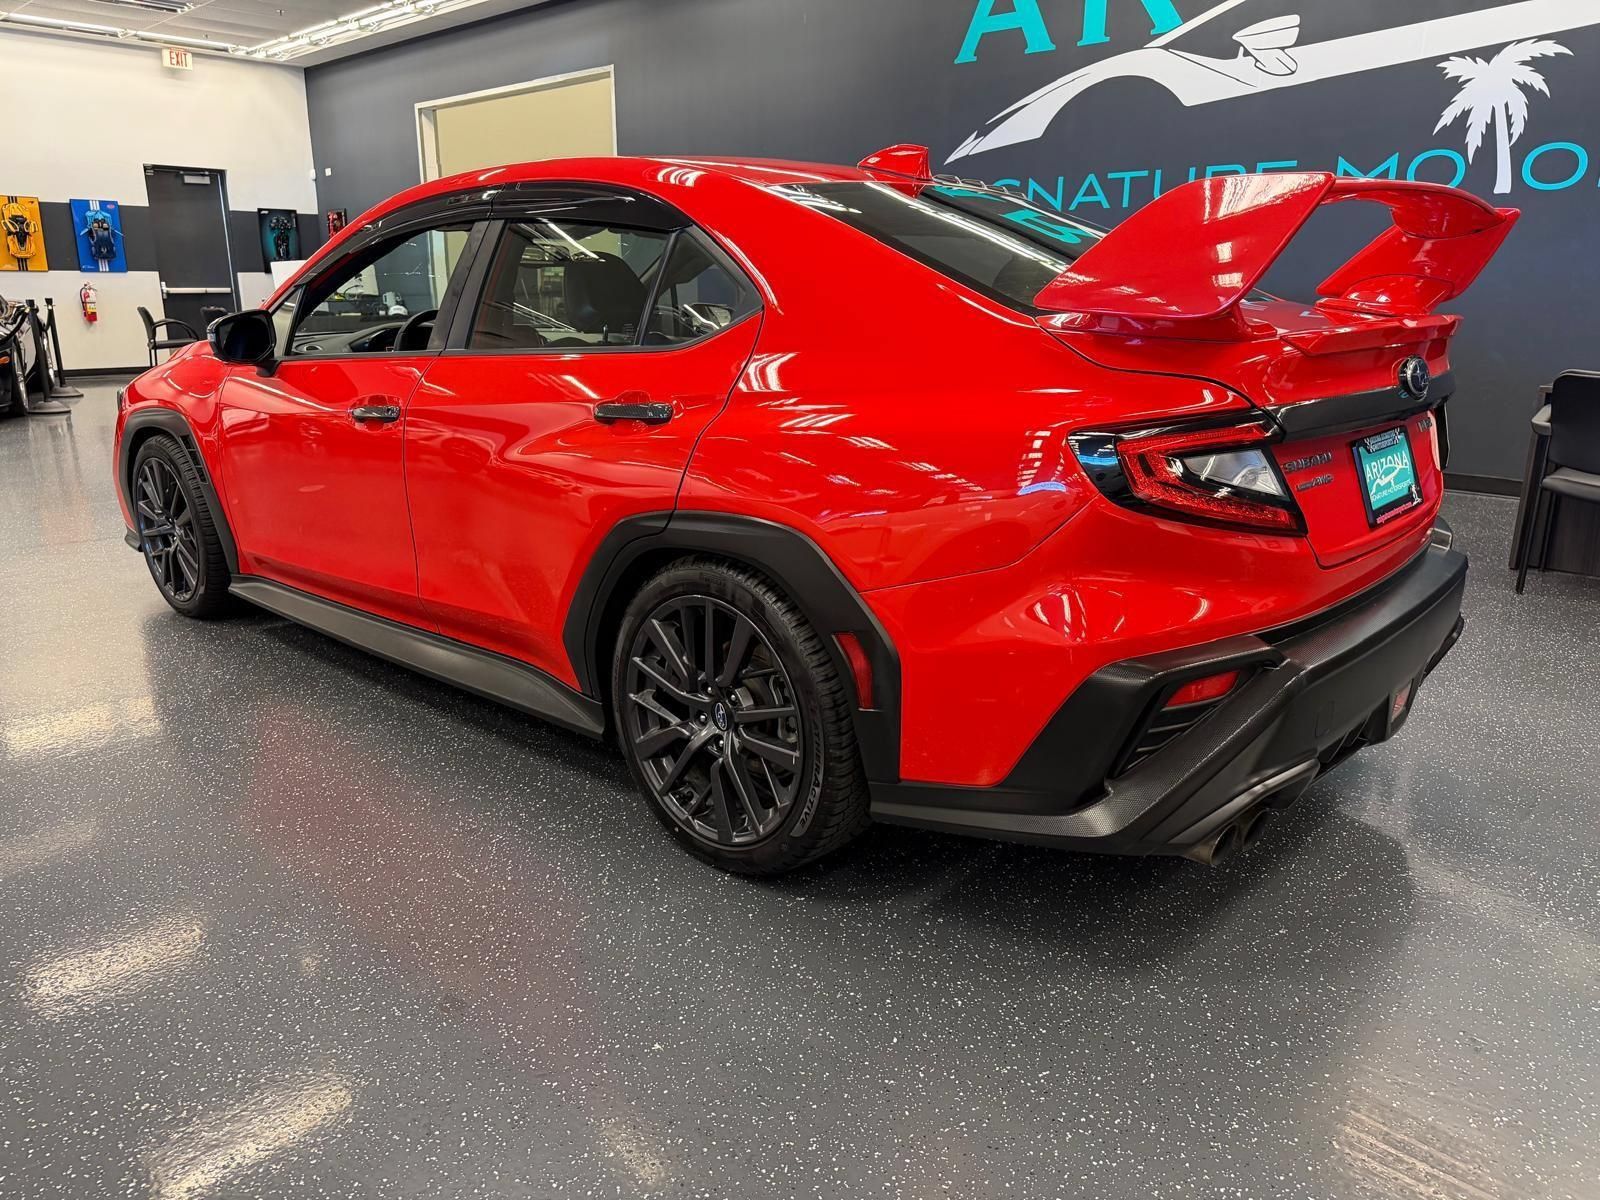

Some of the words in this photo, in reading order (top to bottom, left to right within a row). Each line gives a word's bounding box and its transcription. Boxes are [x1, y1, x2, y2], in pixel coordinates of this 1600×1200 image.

[169, 50, 188, 68] EXIT
[1284, 451, 1332, 471] SUBARU
[1365, 450, 1410, 481] ARIZONA
